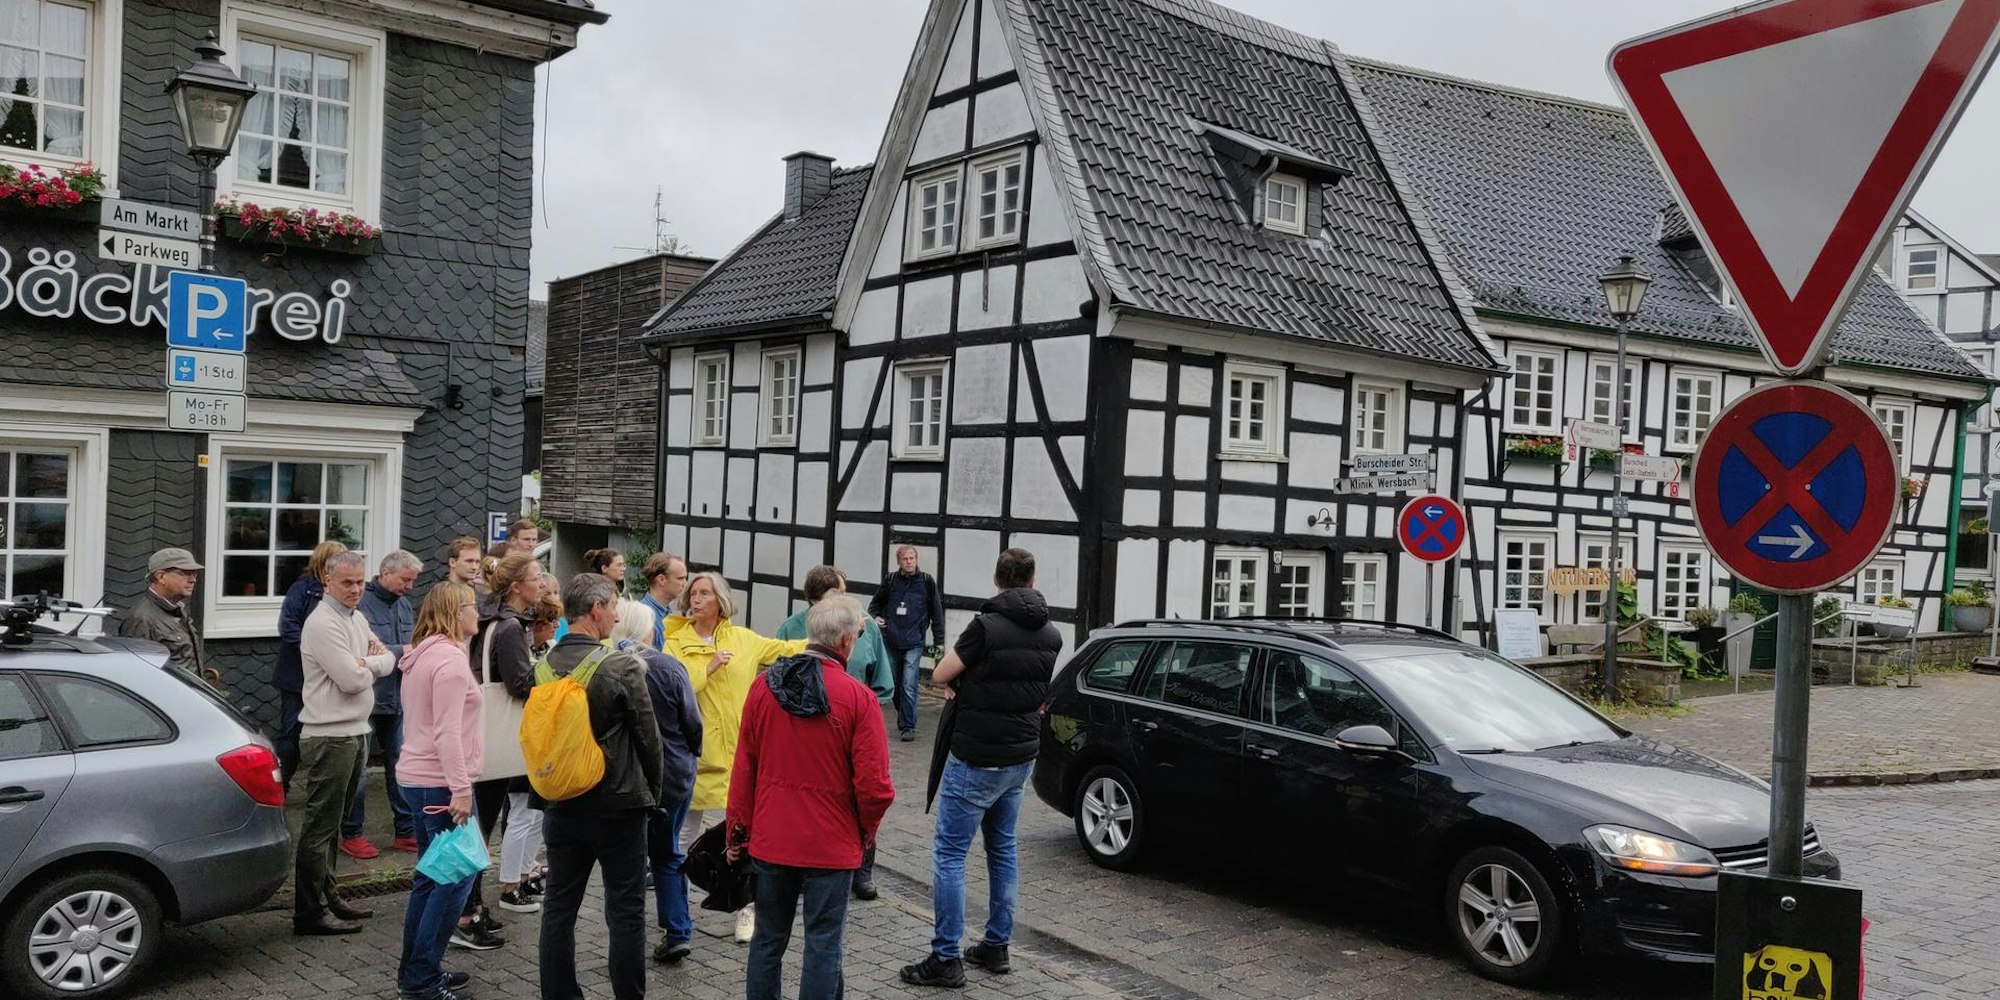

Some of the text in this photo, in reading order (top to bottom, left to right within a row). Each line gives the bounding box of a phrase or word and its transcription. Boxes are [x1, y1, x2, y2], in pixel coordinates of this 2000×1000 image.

[113, 204, 189, 232] Am Markt
[124, 238, 189, 267] Parkweg
[0, 246, 350, 344] äckrei
[187, 283, 228, 338] P
[212, 366, 238, 380] Std.
[185, 397, 230, 412] Mo-Fr
[1357, 456, 1424, 469] Burscheider Str.
[1350, 476, 1418, 490] Klinik Wersbach
